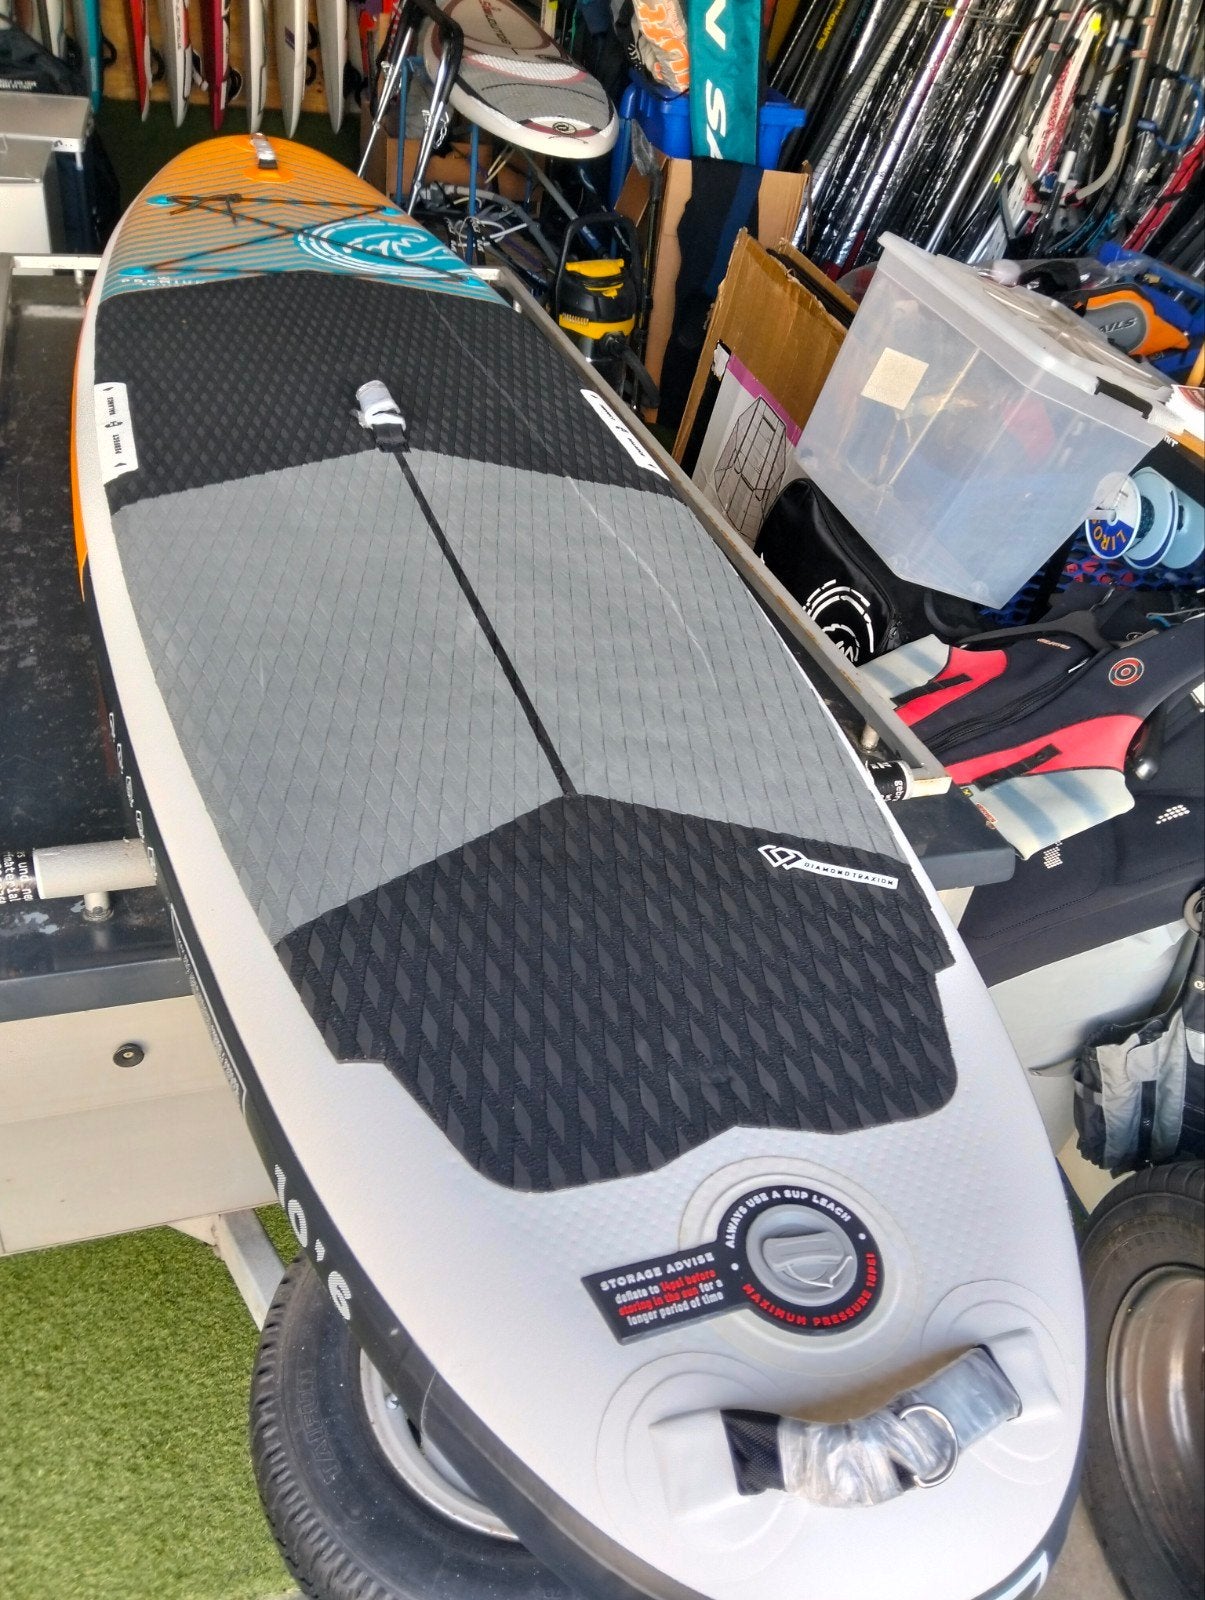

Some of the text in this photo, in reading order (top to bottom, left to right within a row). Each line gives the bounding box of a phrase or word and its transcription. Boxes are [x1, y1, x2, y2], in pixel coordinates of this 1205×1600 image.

[1092, 518, 1127, 551] LIRO
[803, 862, 894, 886] DIAMONDTRAXION
[725, 1189, 852, 1249] ALWAYS USE A SUP LEACH
[600, 1251, 715, 1291] STORAGE ADVISE
[615, 1287, 649, 1304] deflate
[648, 1284, 661, 1295] to
[684, 1269, 717, 1285] before
[618, 1298, 653, 1316] storing
[653, 1295, 665, 1307] in
[664, 1291, 682, 1303] the
[699, 1280, 715, 1293] for
[715, 1279, 724, 1288] a
[626, 1291, 724, 1326] longer period of time
[742, 1283, 808, 1326] MAXIMUM
[812, 1289, 873, 1327] PRESSURE
